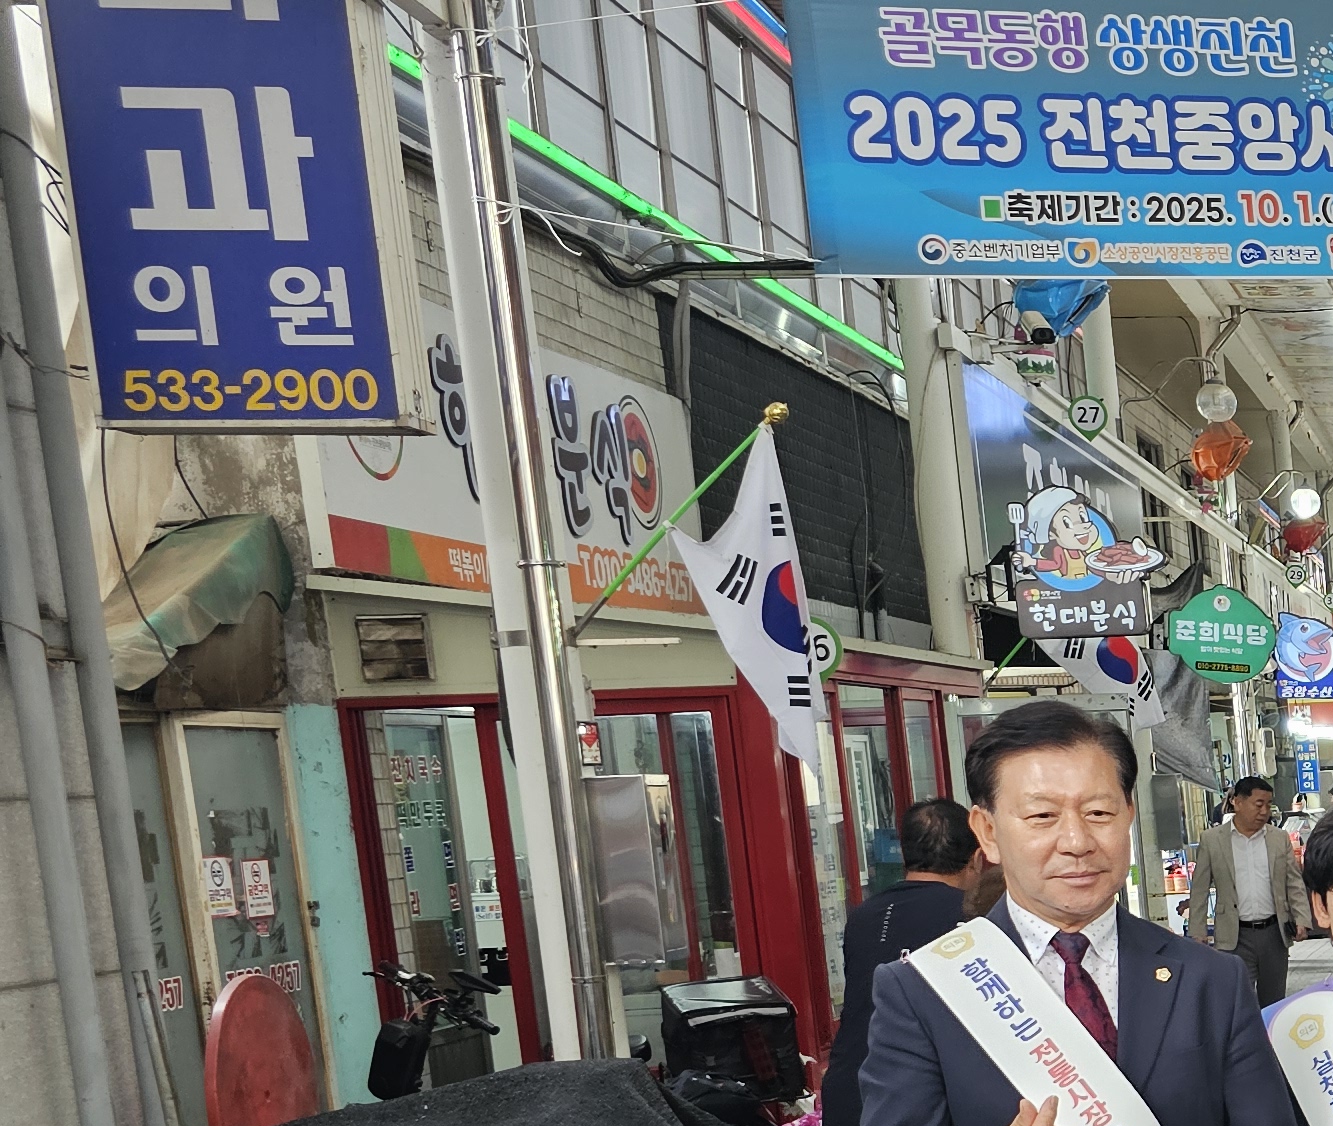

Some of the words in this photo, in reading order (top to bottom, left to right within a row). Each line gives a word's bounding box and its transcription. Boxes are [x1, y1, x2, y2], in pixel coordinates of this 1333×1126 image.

[880, 8, 1087, 73] 골목동행
[1097, 13, 1297, 77] 상생진천
[848, 95, 1022, 163] 2025
[1005, 191, 1121, 224] 축제기간
[1146, 195, 1234, 224] 2025.
[1240, 192, 1290, 224] 10.
[951, 240, 1063, 262] 중소벤처기업부
[1102, 244, 1232, 264] 소상공인시장진흥공단
[1270, 246, 1320, 262] 진천군
[124, 369, 379, 411] 533-2900
[1077, 407, 1099, 423] 27
[547, 374, 634, 546] 분식
[1290, 571, 1302, 580] 29
[1029, 600, 1137, 632] 현대분식
[1176, 620, 1268, 645] 준희식당
[1282, 686, 1333, 698] 중앙수산
[390, 755, 442, 784] 잔치국수
[1302, 762, 1314, 790] 오케이
[960, 957, 1043, 1042] 함께하는
